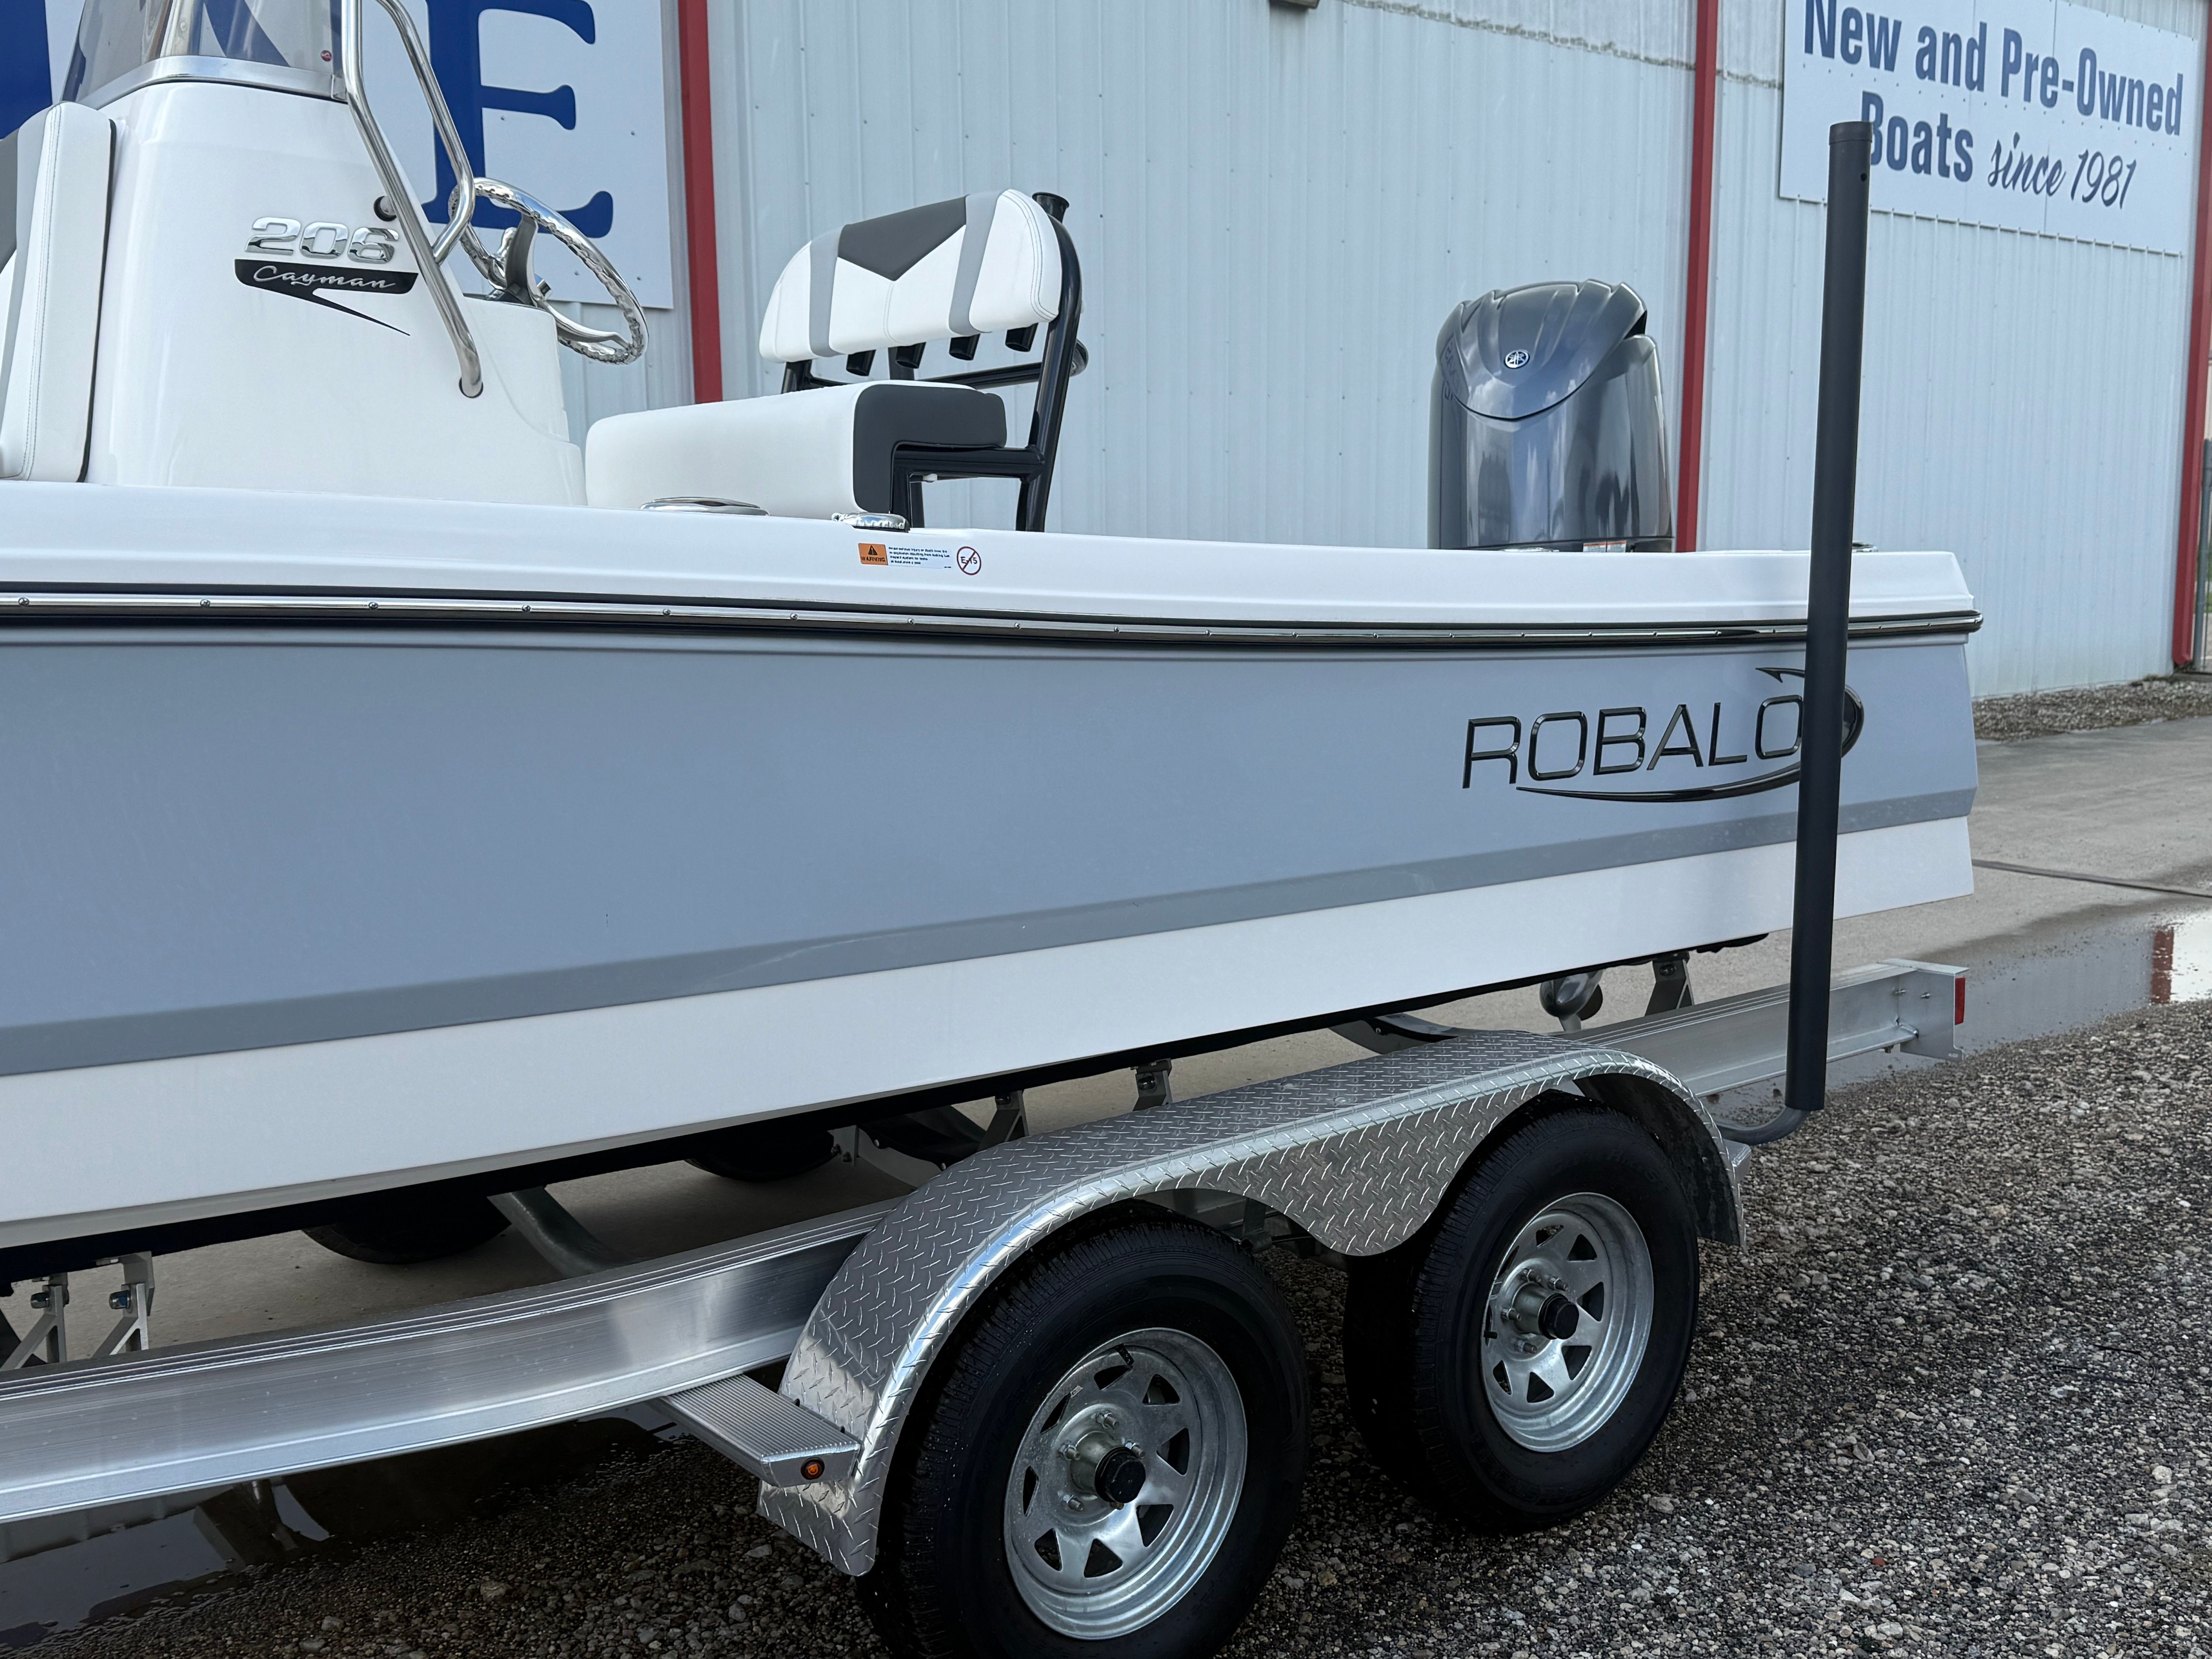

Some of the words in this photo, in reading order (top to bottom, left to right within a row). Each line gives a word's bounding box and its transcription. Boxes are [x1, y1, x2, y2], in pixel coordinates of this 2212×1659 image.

[1804, 0, 1902, 72] New
[1915, 21, 1987, 92] and
[2001, 27, 2184, 136] Pre-Owned
[1862, 91, 1973, 182] Boats
[1987, 132, 2066, 197] since
[2070, 149, 2137, 210] 1981
[244, 216, 399, 264] 206
[253, 265, 396, 289] Cayman
[1462, 694, 1803, 788] ROBALO
